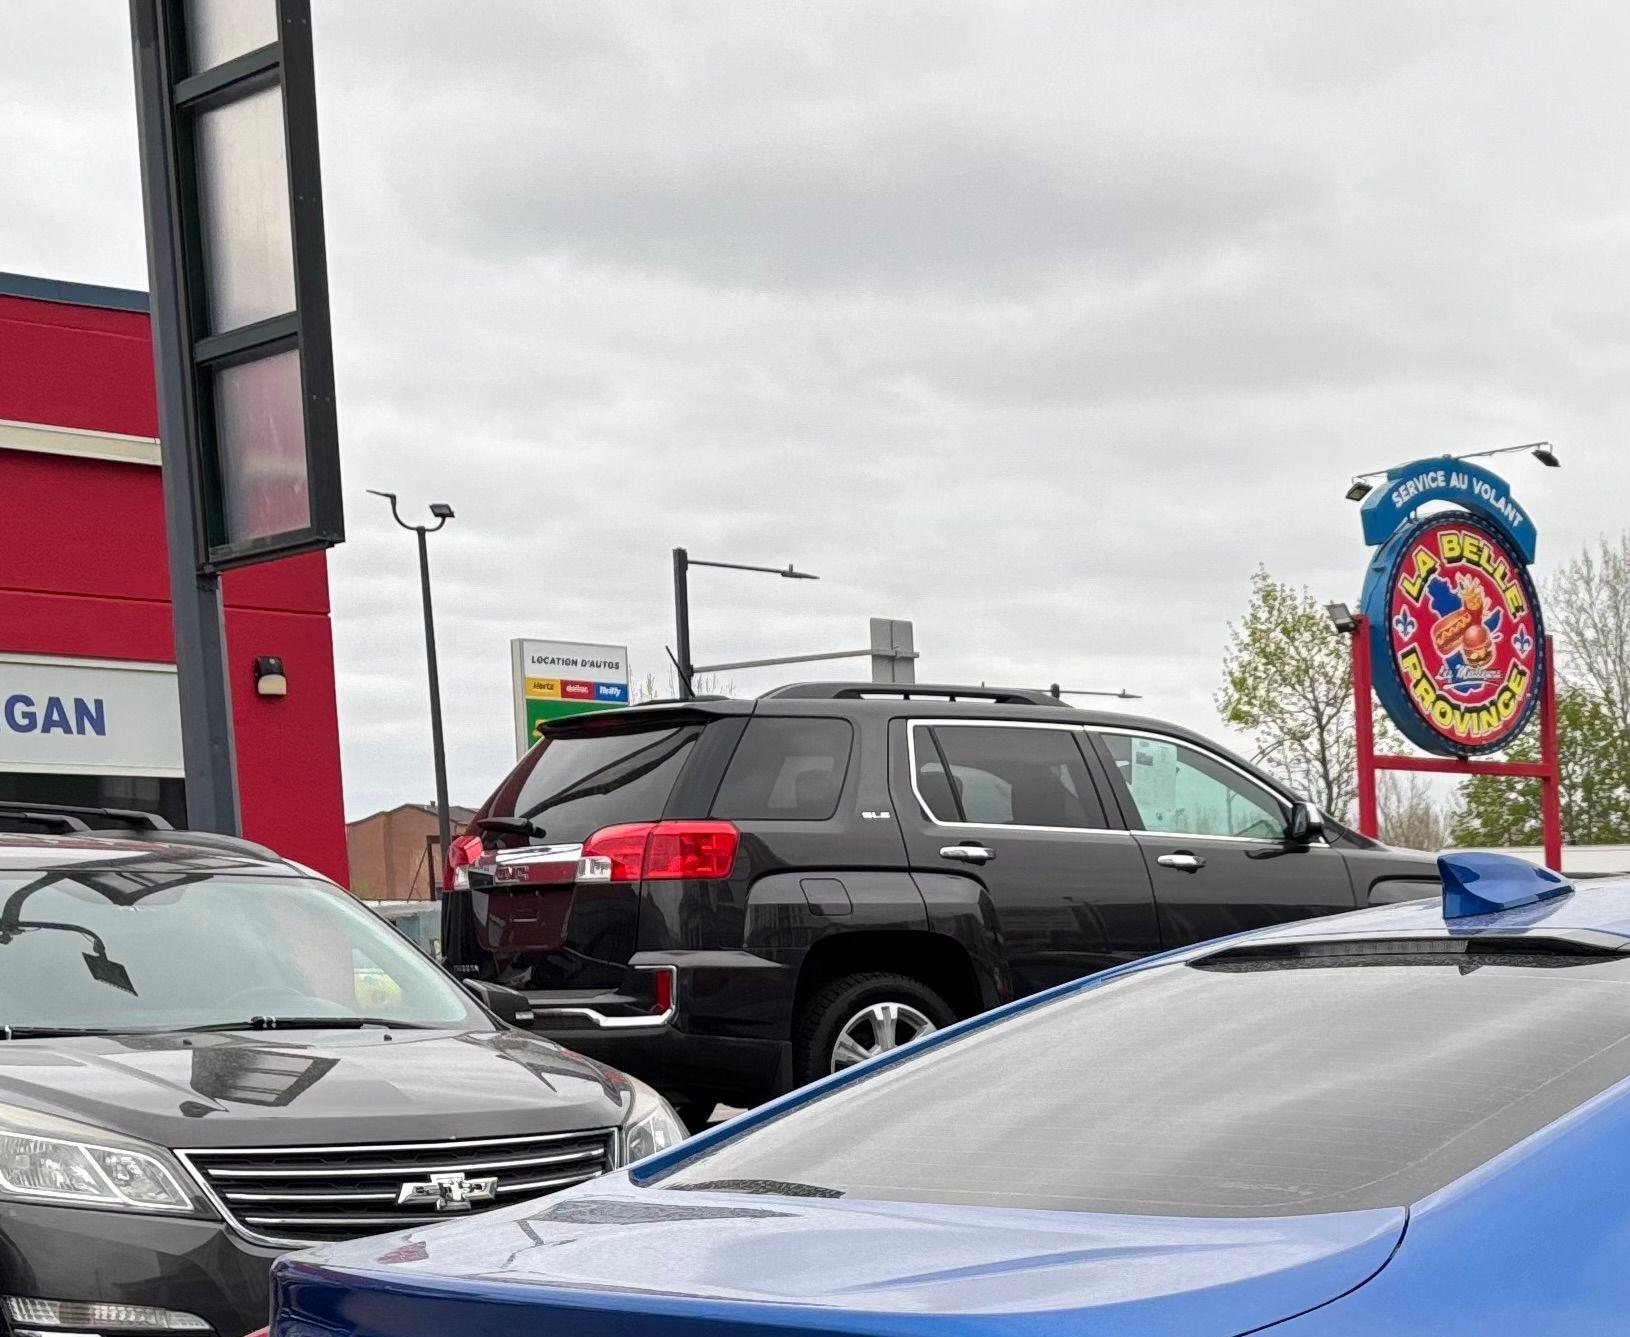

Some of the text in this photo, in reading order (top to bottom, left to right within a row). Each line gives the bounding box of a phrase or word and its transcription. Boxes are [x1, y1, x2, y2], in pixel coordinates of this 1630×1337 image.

[1391, 470, 1524, 528] SERVICE AU VOLANT
[1400, 531, 1527, 618] LA BELLE
[531, 655, 620, 670] LOCATION D'AUTOS
[1400, 644, 1529, 736] PROVINCE
[4, 693, 107, 737] GAN
